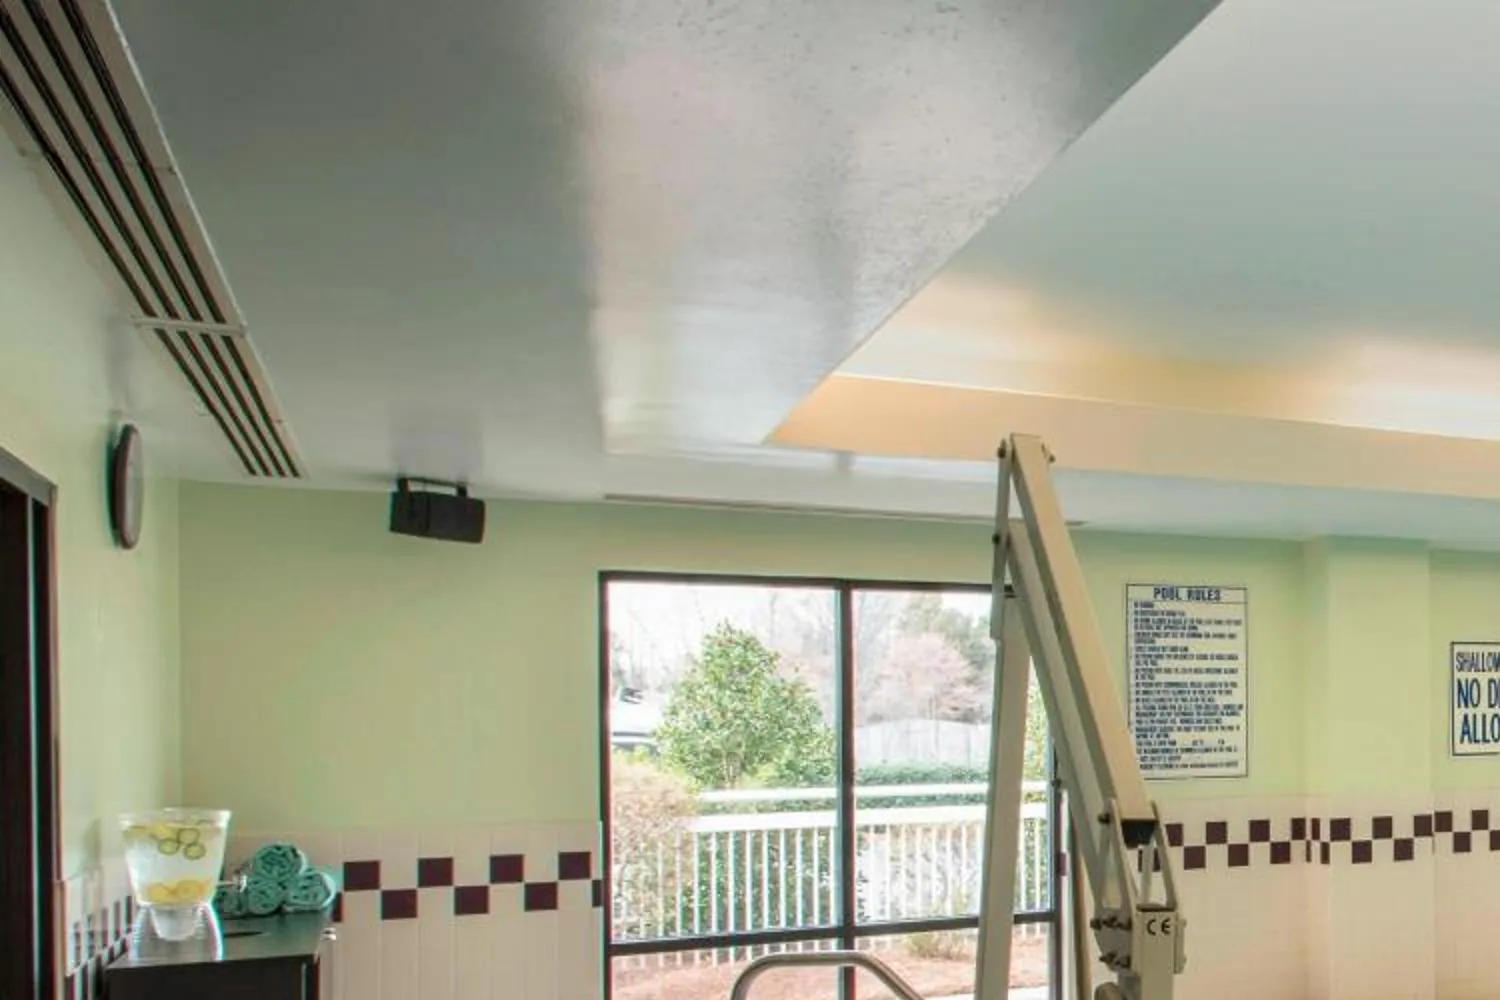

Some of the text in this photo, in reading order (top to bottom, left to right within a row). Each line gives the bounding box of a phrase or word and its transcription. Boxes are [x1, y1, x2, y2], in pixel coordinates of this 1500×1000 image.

[1153, 587, 1221, 601] POOL RULES
[1457, 678, 1481, 709] NO
[1147, 918, 1170, 936] CE
